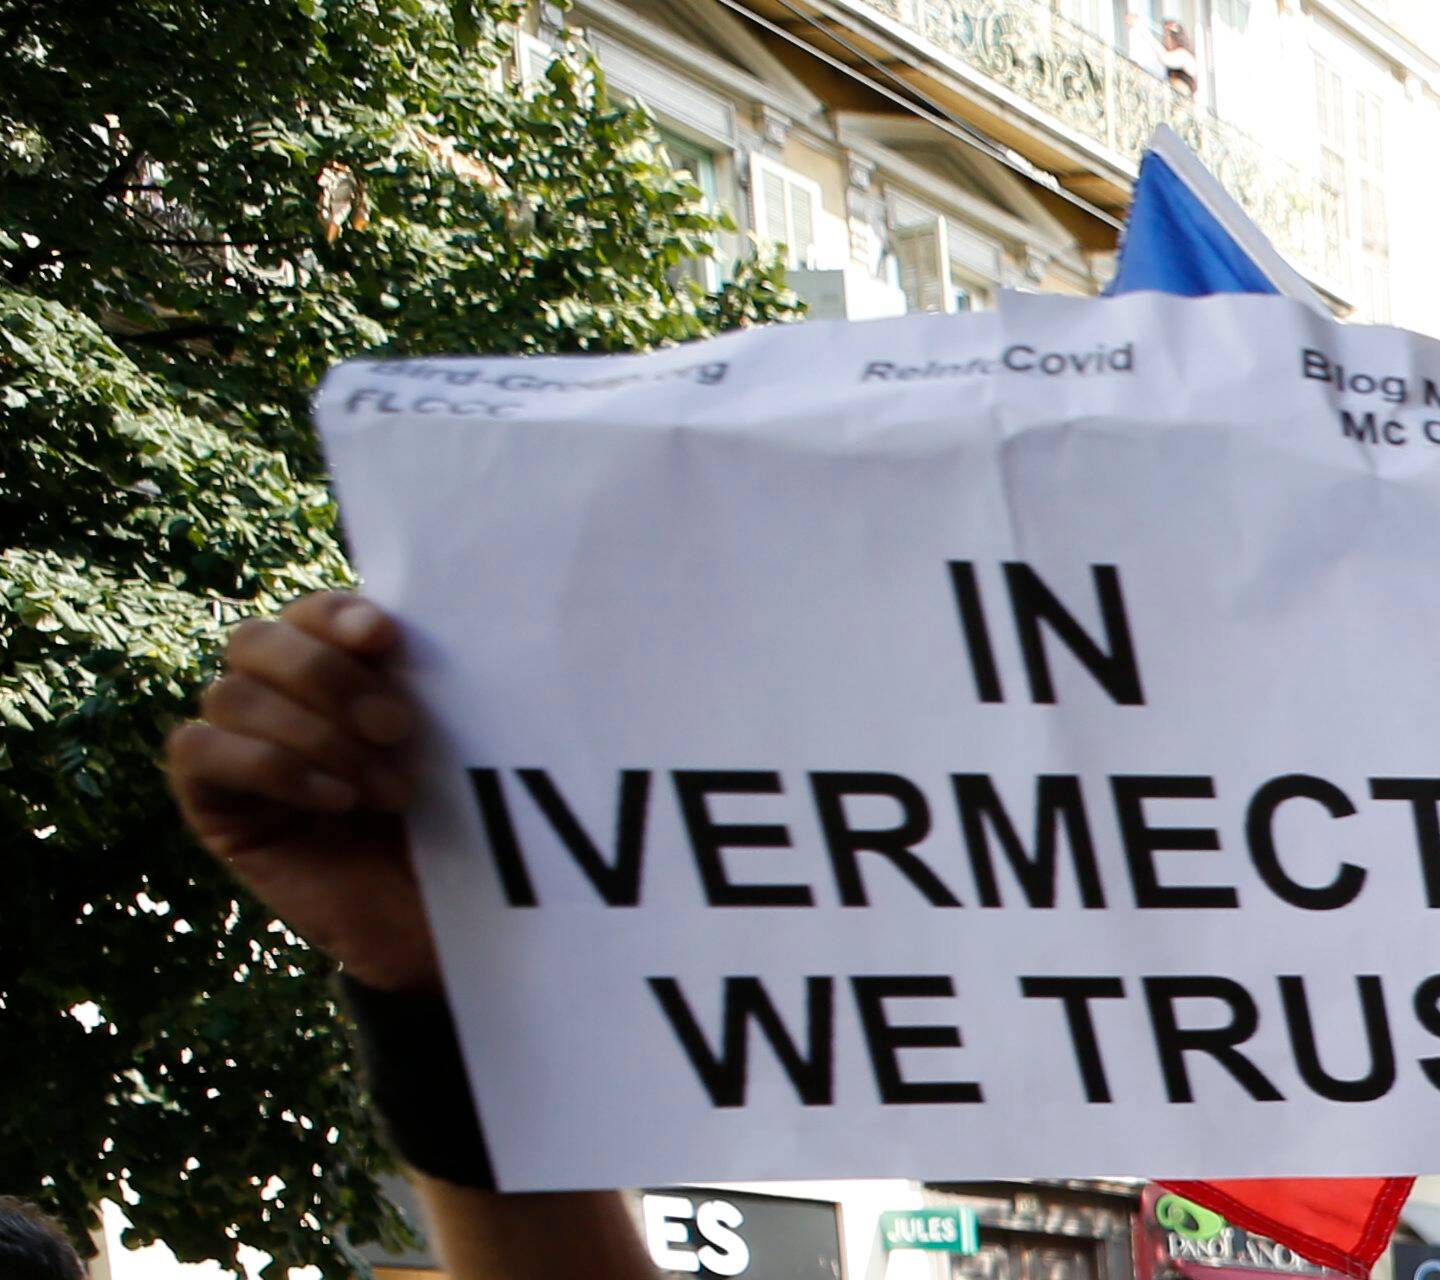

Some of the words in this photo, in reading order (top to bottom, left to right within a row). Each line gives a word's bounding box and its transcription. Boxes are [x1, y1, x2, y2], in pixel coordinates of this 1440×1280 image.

[1301, 349, 1408, 403] Blog
[1339, 410, 1406, 446] Mc
[945, 559, 1147, 706] IN
[645, 974, 986, 1107] WE
[886, 1215, 959, 1243] JULES
